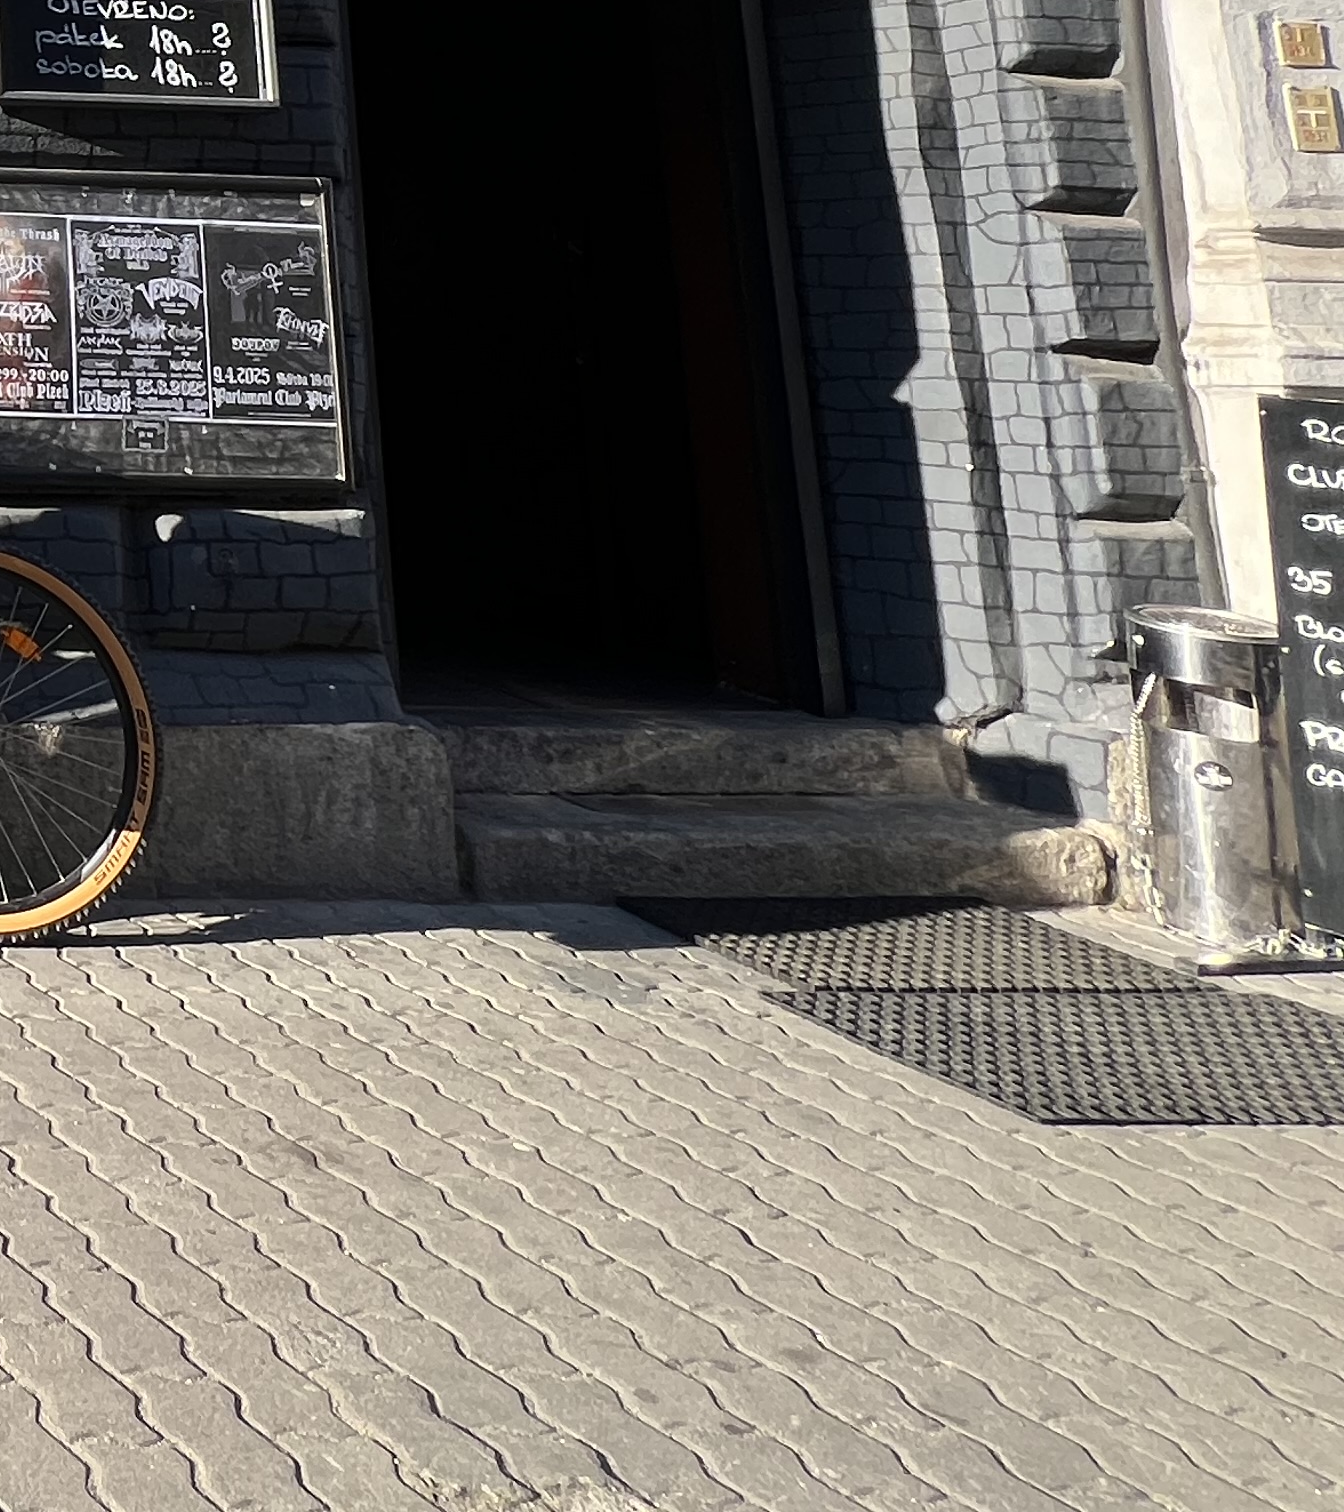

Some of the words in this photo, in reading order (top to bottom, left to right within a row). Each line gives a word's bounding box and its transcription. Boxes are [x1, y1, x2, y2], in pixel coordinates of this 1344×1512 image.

[35, 22, 124, 53] pátek
[36, 55, 139, 80] sobota
[18, 227, 60, 242] Thrash
[1287, 565, 1333, 595] 35
